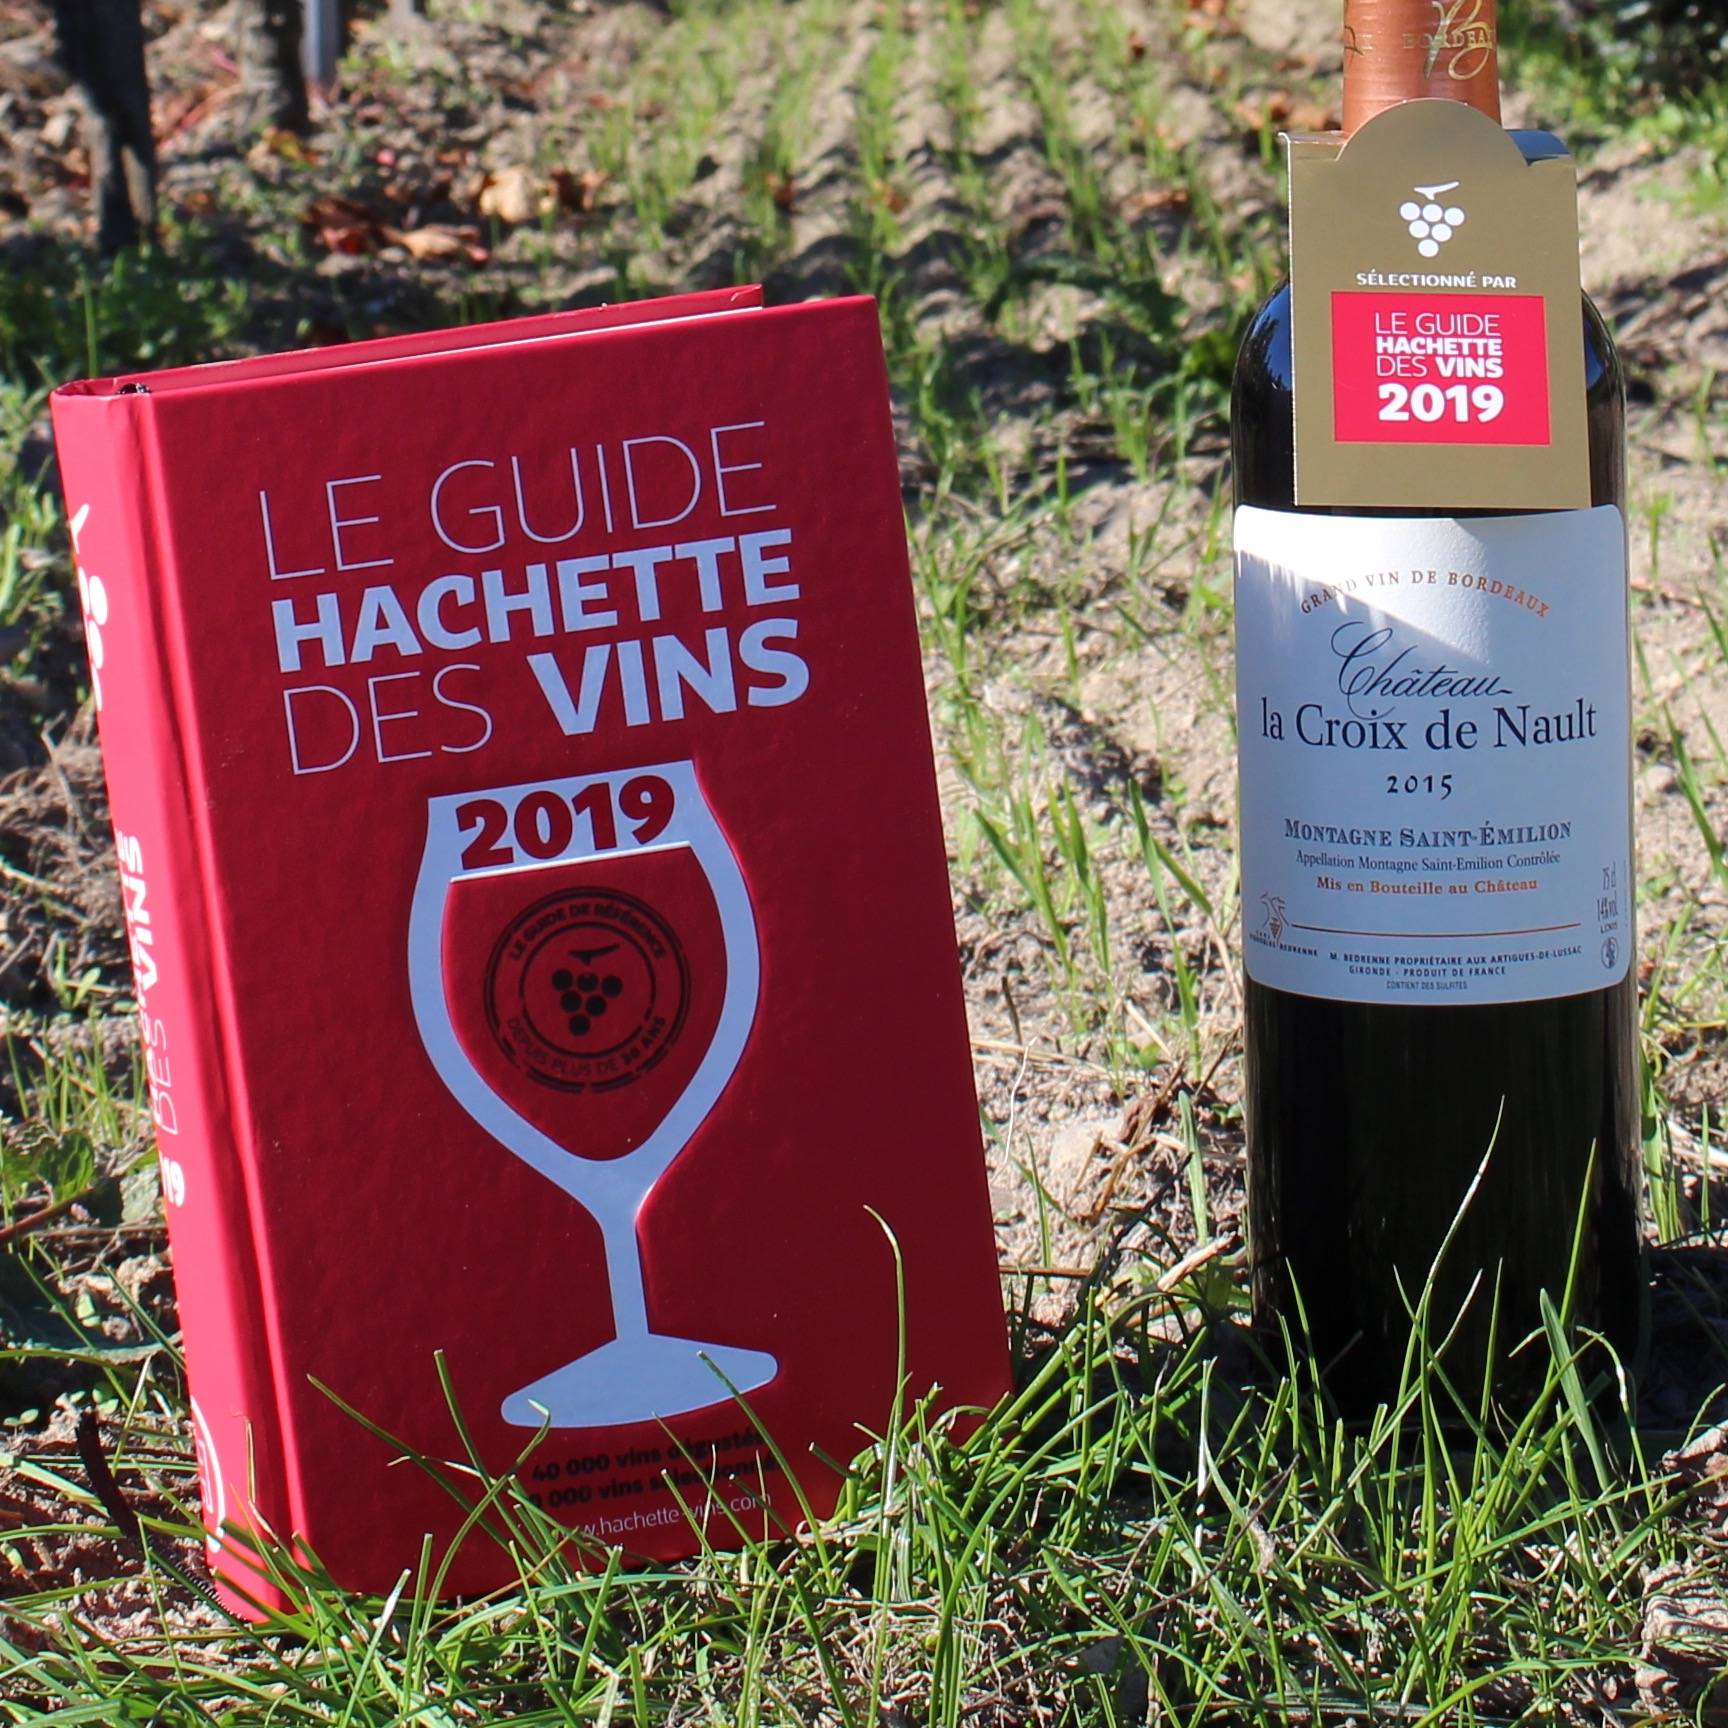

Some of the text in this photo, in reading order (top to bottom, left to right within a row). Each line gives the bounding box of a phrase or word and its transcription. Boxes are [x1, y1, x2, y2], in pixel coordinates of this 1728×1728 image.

[1356, 269, 1516, 289] SÉLECTIONNÉ PAR
[1375, 312, 1501, 337] LE GUIDE
[1376, 336, 1503, 356] HACHETTE
[1376, 355, 1504, 378] DES VINS
[1378, 383, 1504, 423] 2019
[259, 420, 777, 580] LE GUIDE
[271, 528, 801, 673] HACHETTE
[1300, 570, 1551, 618] GRAND VIN DE BORDEAUX
[1331, 621, 1513, 720] Château
[282, 618, 811, 776] DES VINS
[1261, 697, 1597, 750] la Croix de Nault
[1386, 775, 1452, 800] 2015
[455, 774, 675, 871] 2019
[1284, 818, 1572, 848] MONTAGNE SAINT-ÉMILION
[1296, 849, 1561, 874] Appellation Montagne Saint-Emilion Contrôlée
[1316, 876, 1537, 895] Mis en Bouteille au Château
[124, 833, 159, 993] VINS
[569, 903, 592, 916] DE
[1394, 955, 1462, 966] PROPRIÉTAIRE
[1466, 956, 1487, 966] AUX
[1490, 945, 1582, 964] ARTIGUES-DE-LUSSAC
[1349, 965, 1391, 977] GIRONDE
[1403, 968, 1446, 977] PRODUIT
[1452, 968, 1464, 977] DE
[1469, 966, 1506, 976] FRANCE
[1386, 980, 1419, 990] CONTIENT
[532, 1461, 560, 1482] 40
[566, 1453, 610, 1477] 000
[616, 1446, 661, 1469] vins
[549, 1483, 592, 1507] 000
[598, 1476, 645, 1499] vins
